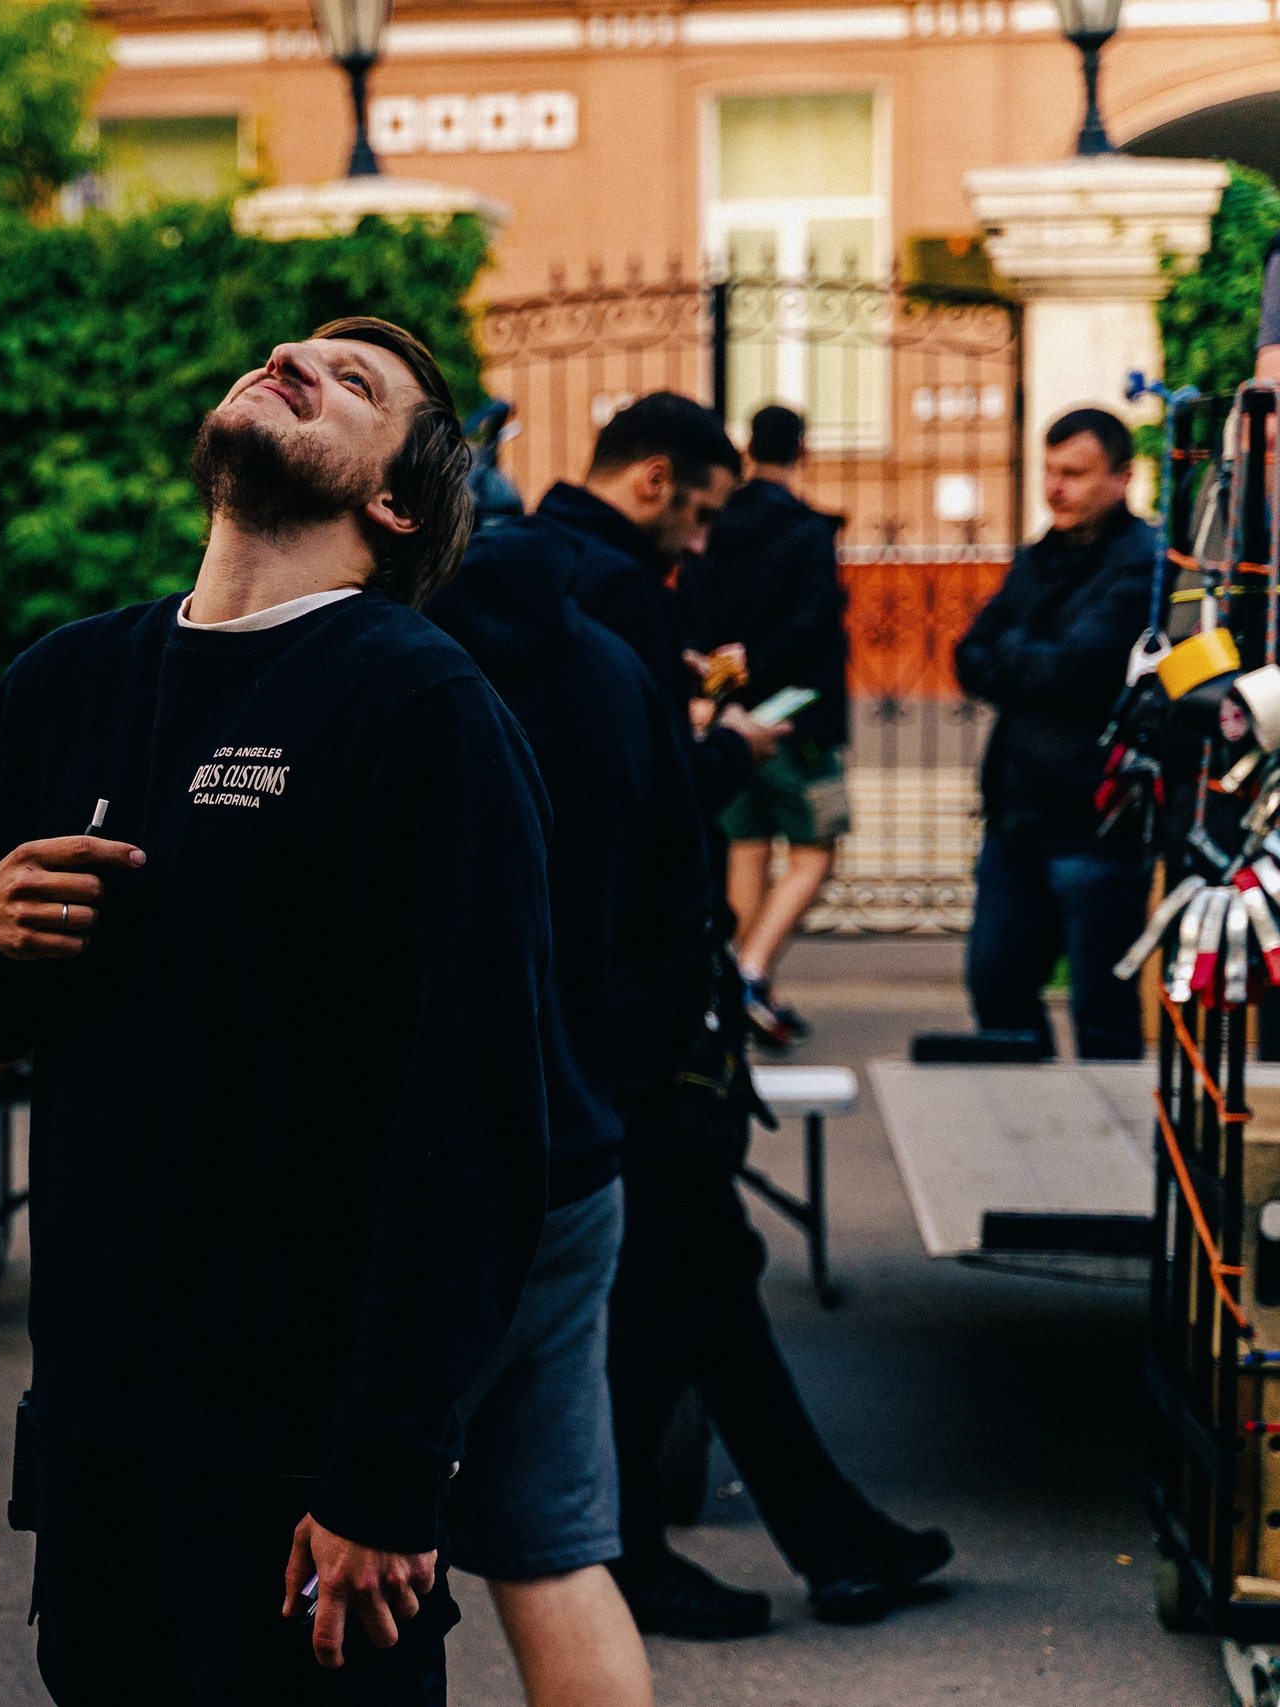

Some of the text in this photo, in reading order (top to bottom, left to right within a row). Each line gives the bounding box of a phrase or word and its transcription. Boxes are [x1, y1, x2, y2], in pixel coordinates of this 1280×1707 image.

[213, 747, 282, 759] LOS ANGELES
[188, 764, 290, 796] DEUS CUSTOMS
[193, 793, 260, 809] CALIFORNIA
